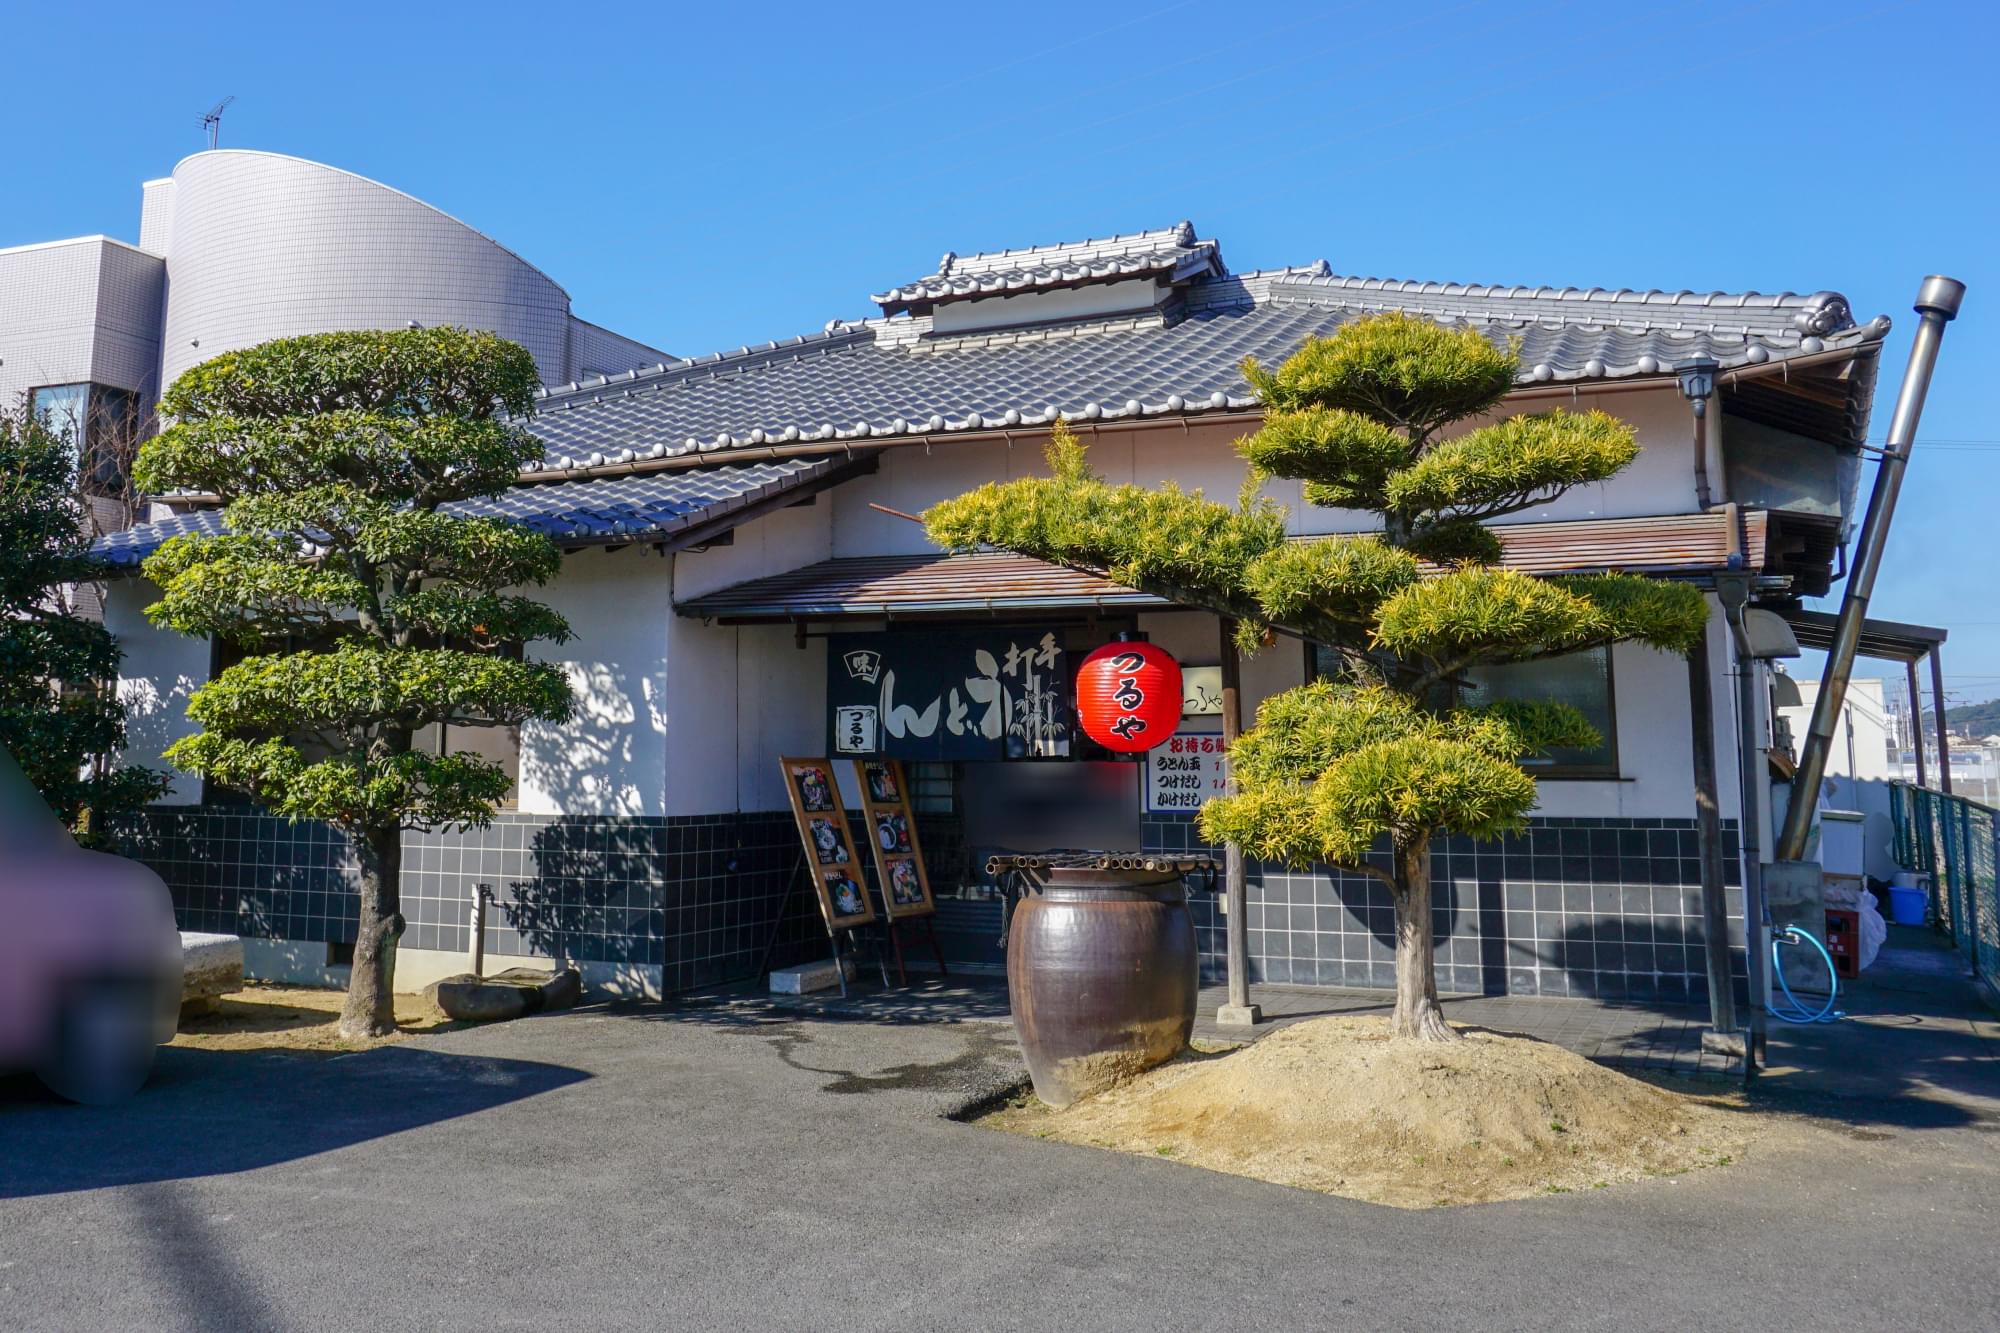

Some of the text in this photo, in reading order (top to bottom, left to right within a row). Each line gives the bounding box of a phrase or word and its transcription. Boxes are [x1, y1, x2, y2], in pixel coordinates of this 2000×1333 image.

[852, 653, 873, 673] 味
[880, 649, 1012, 740] うどん
[1110, 651, 1147, 740] つるや
[1185, 685, 1223, 712] つるや
[849, 711, 865, 748] つるや
[1157, 775, 1201, 789] つけだし
[1157, 792, 1201, 807] かけだし
